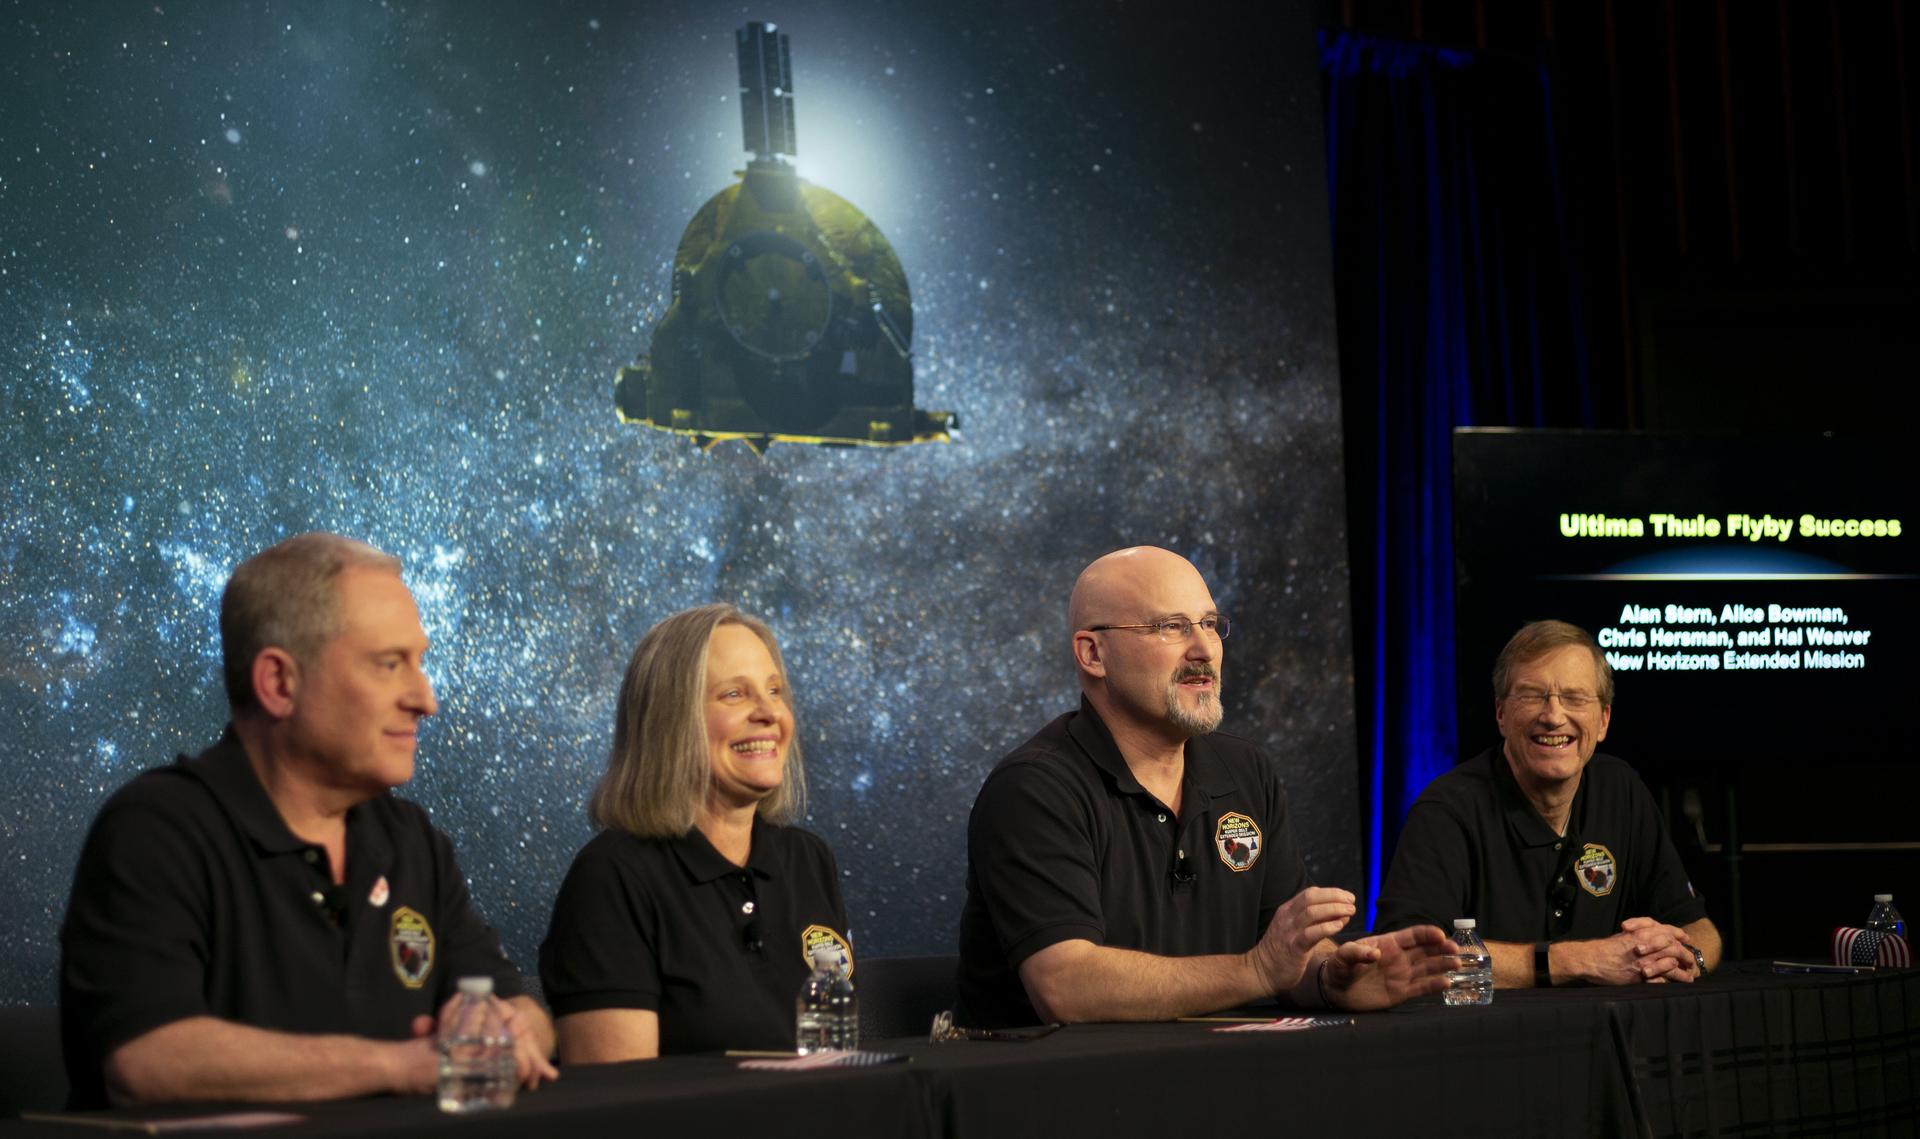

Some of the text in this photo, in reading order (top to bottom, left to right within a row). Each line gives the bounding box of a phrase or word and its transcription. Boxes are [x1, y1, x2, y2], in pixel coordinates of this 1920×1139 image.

[1559, 513, 1902, 541] Ultima Thule Flyby Success
[1619, 603, 1849, 626] Alan Stern, Alice Bowman,
[1597, 626, 1872, 649] Chris Hersman, and Hal Weaver
[1604, 649, 1865, 671] New Horizons Extended Mission
